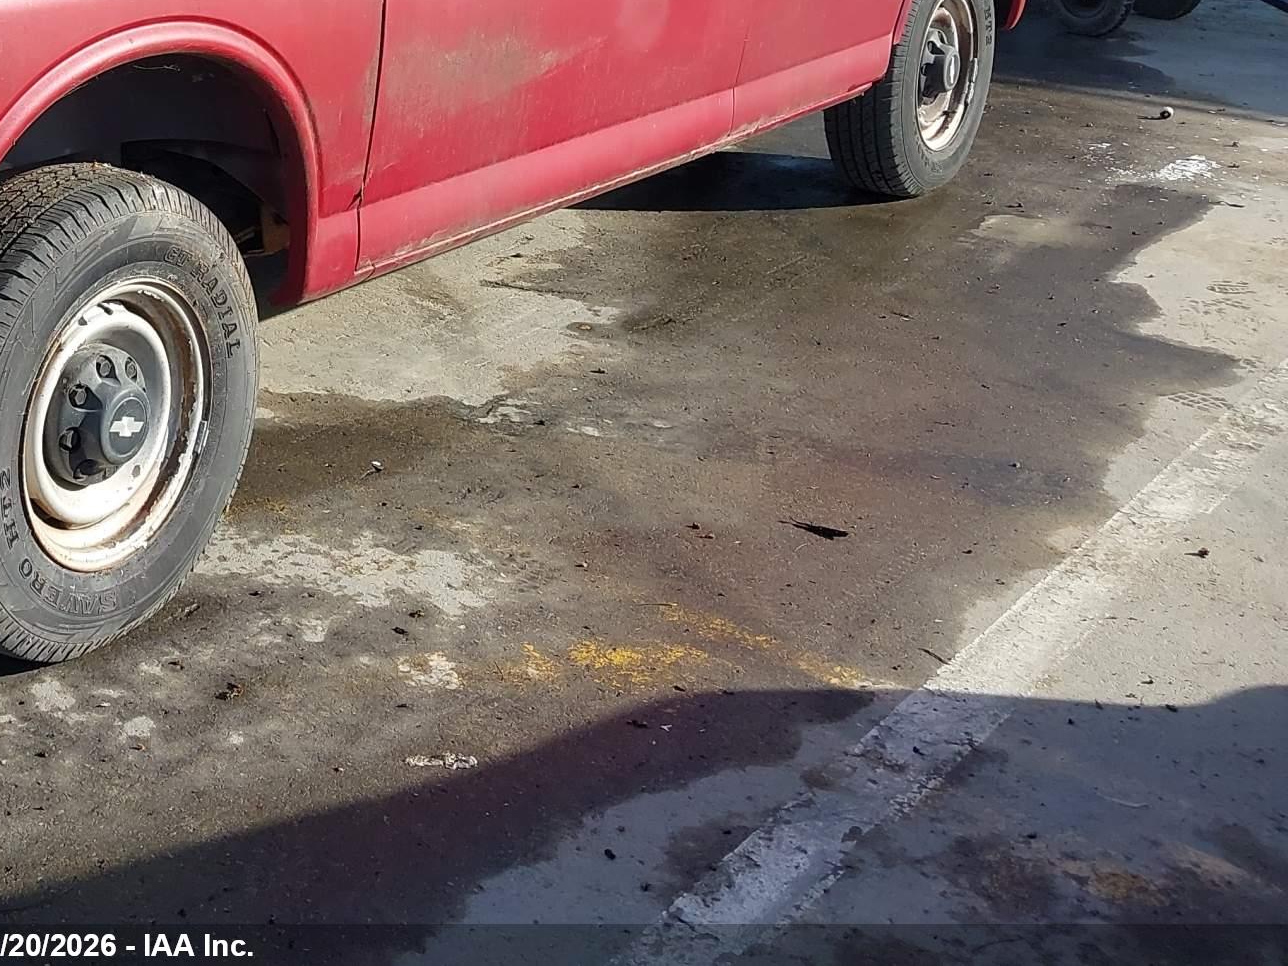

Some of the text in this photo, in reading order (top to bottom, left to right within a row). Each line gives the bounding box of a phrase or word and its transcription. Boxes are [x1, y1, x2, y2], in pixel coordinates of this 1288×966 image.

[163, 244, 194, 267] GT
[189, 260, 241, 359] RADIAL
[0, 469, 118, 616] SAVERO HT2
